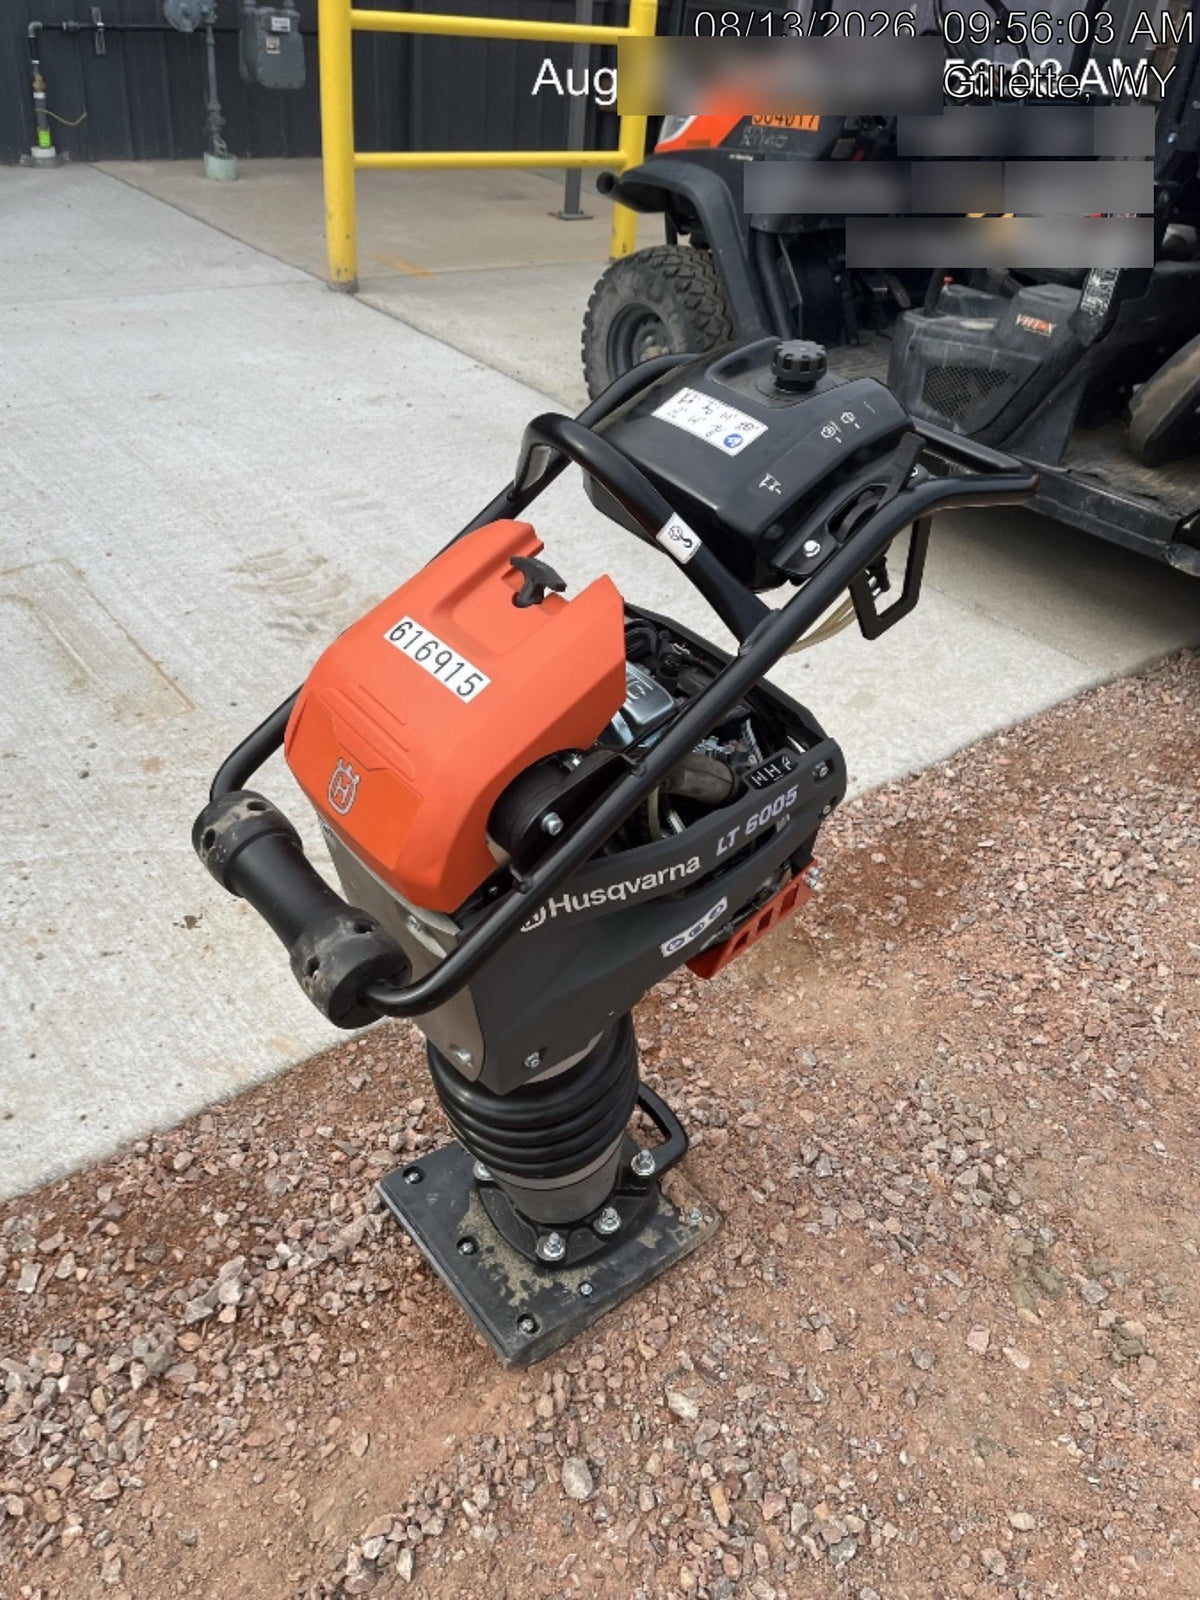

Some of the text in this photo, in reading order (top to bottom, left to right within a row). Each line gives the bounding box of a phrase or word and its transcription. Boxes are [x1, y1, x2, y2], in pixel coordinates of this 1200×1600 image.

[389, 621, 483, 697] 616915
[716, 784, 799, 856] LT 6005
[549, 856, 701, 918] Husqvarna
